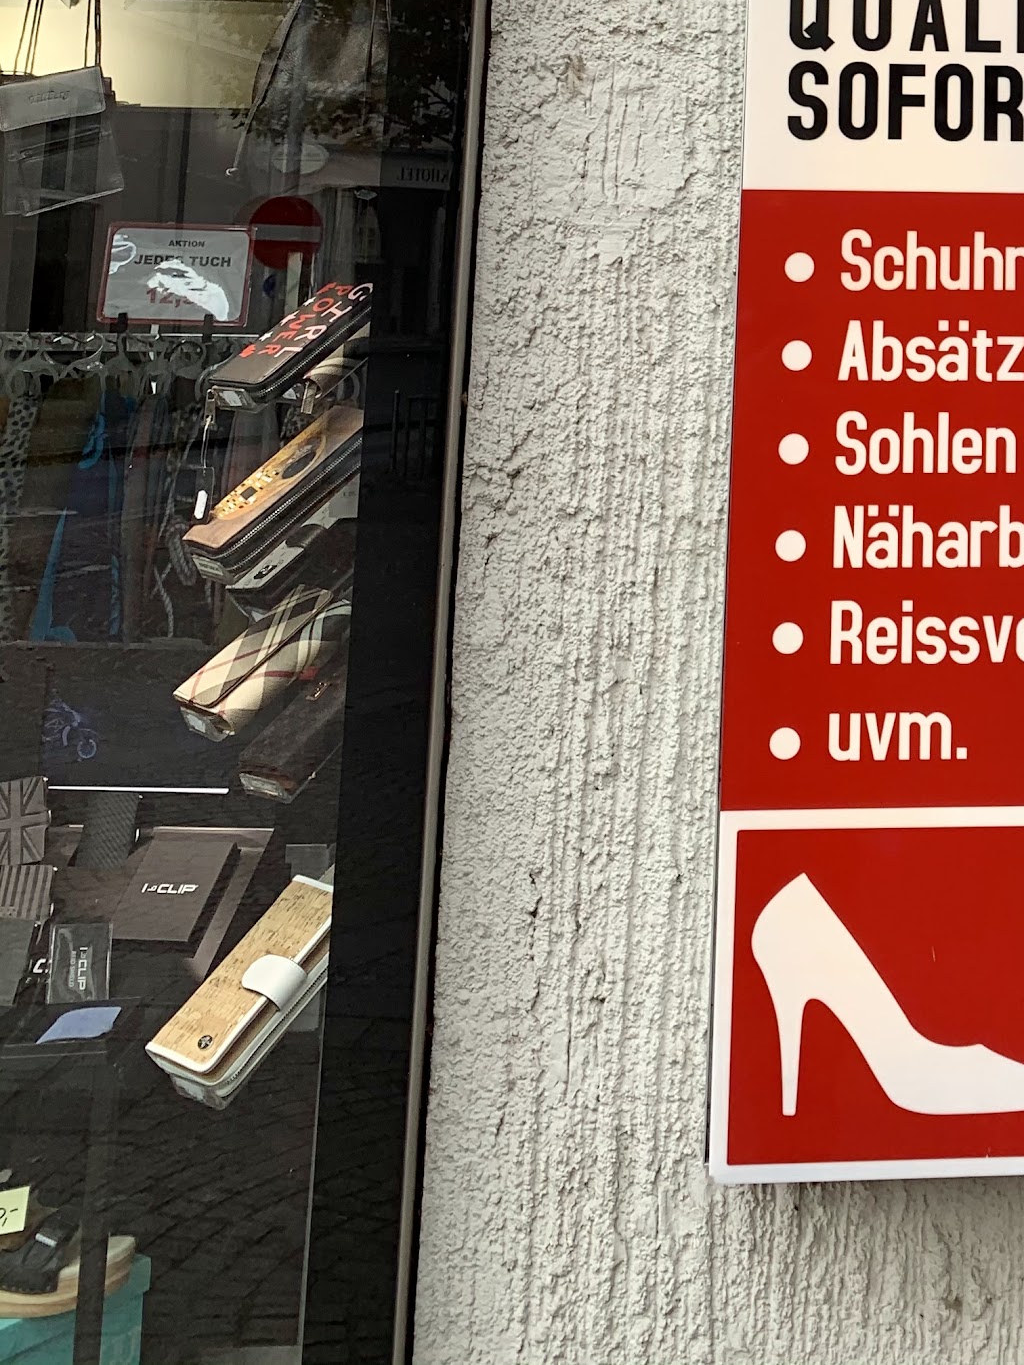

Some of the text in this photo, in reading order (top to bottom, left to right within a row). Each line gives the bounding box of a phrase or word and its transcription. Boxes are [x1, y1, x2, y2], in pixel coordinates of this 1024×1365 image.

[168, 239, 206, 248] AKTION
[189, 255, 232, 268] TUCH
[835, 410, 1017, 476] Sohlen
[828, 711, 968, 761] uvm.
